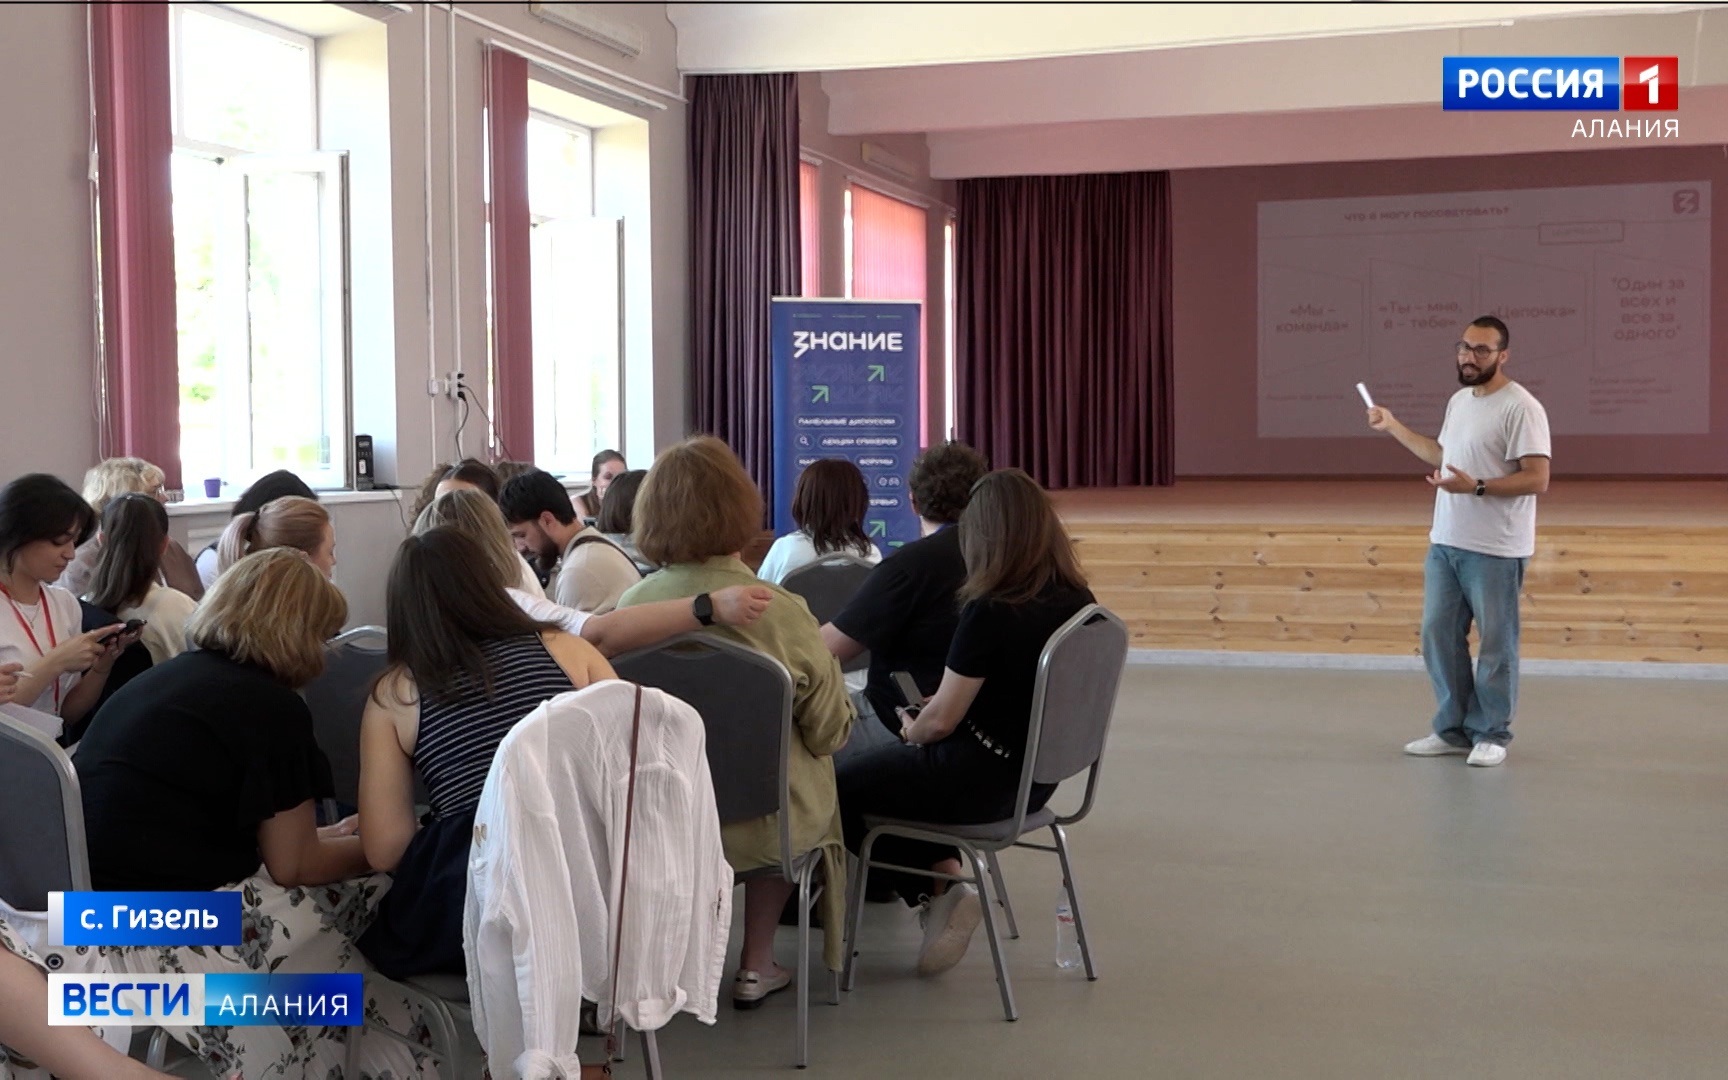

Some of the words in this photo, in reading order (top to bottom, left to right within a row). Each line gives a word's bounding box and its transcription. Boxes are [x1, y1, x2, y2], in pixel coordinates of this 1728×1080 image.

[1380, 211, 1410, 220] МОГУ
[1620, 296, 1660, 308] всех
[1621, 313, 1652, 324] все
[821, 438, 855, 446] ЛЕКЦИИ
[869, 498, 898, 506] ЕРВЬЮ
